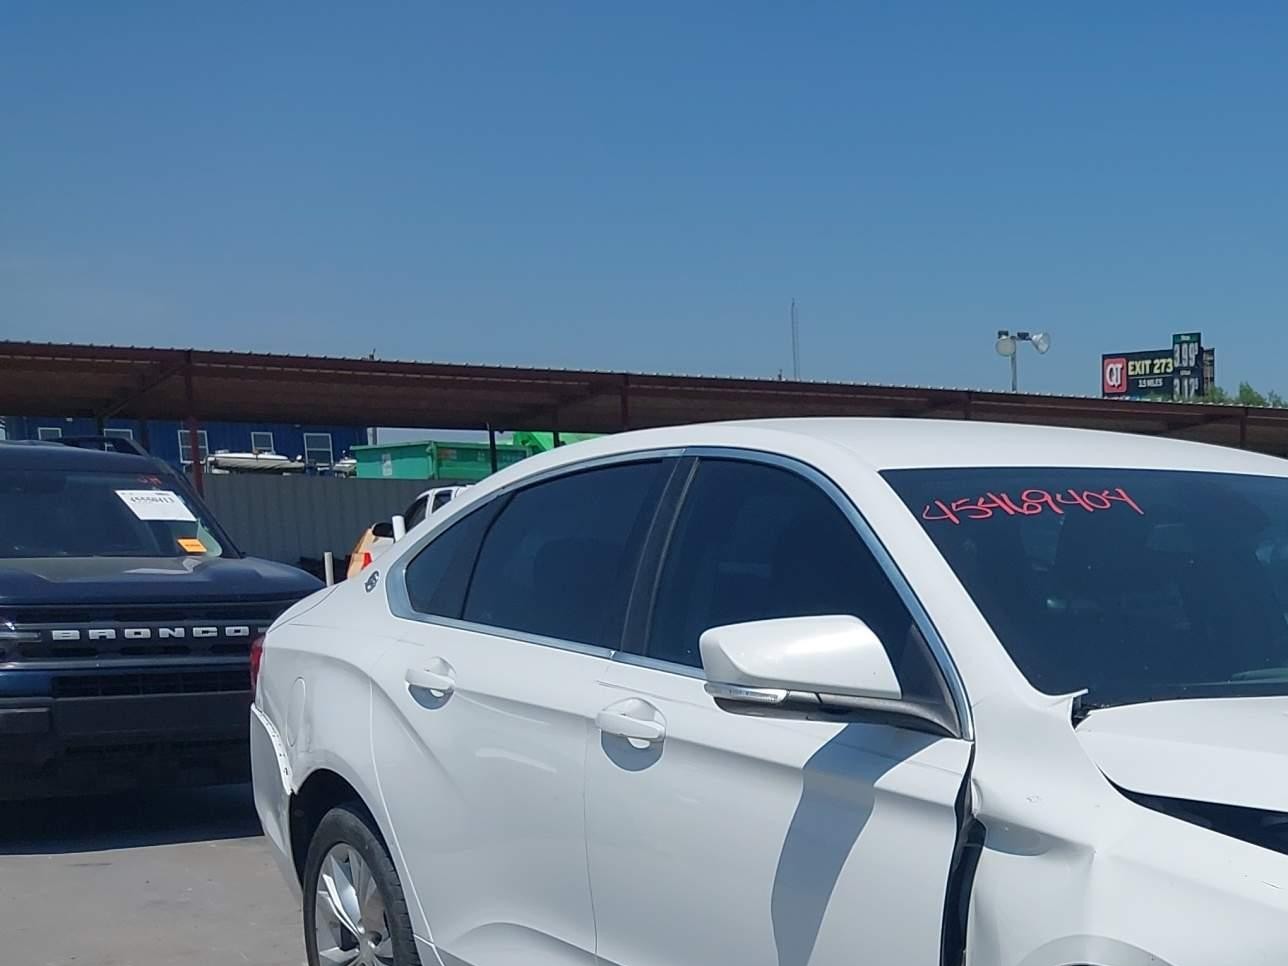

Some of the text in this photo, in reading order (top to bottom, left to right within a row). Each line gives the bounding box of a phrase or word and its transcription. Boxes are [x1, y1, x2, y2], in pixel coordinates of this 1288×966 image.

[1106, 363, 1124, 387] QT
[1128, 358, 1174, 375] EXIT 273
[52, 625, 249, 641] BRONCO
